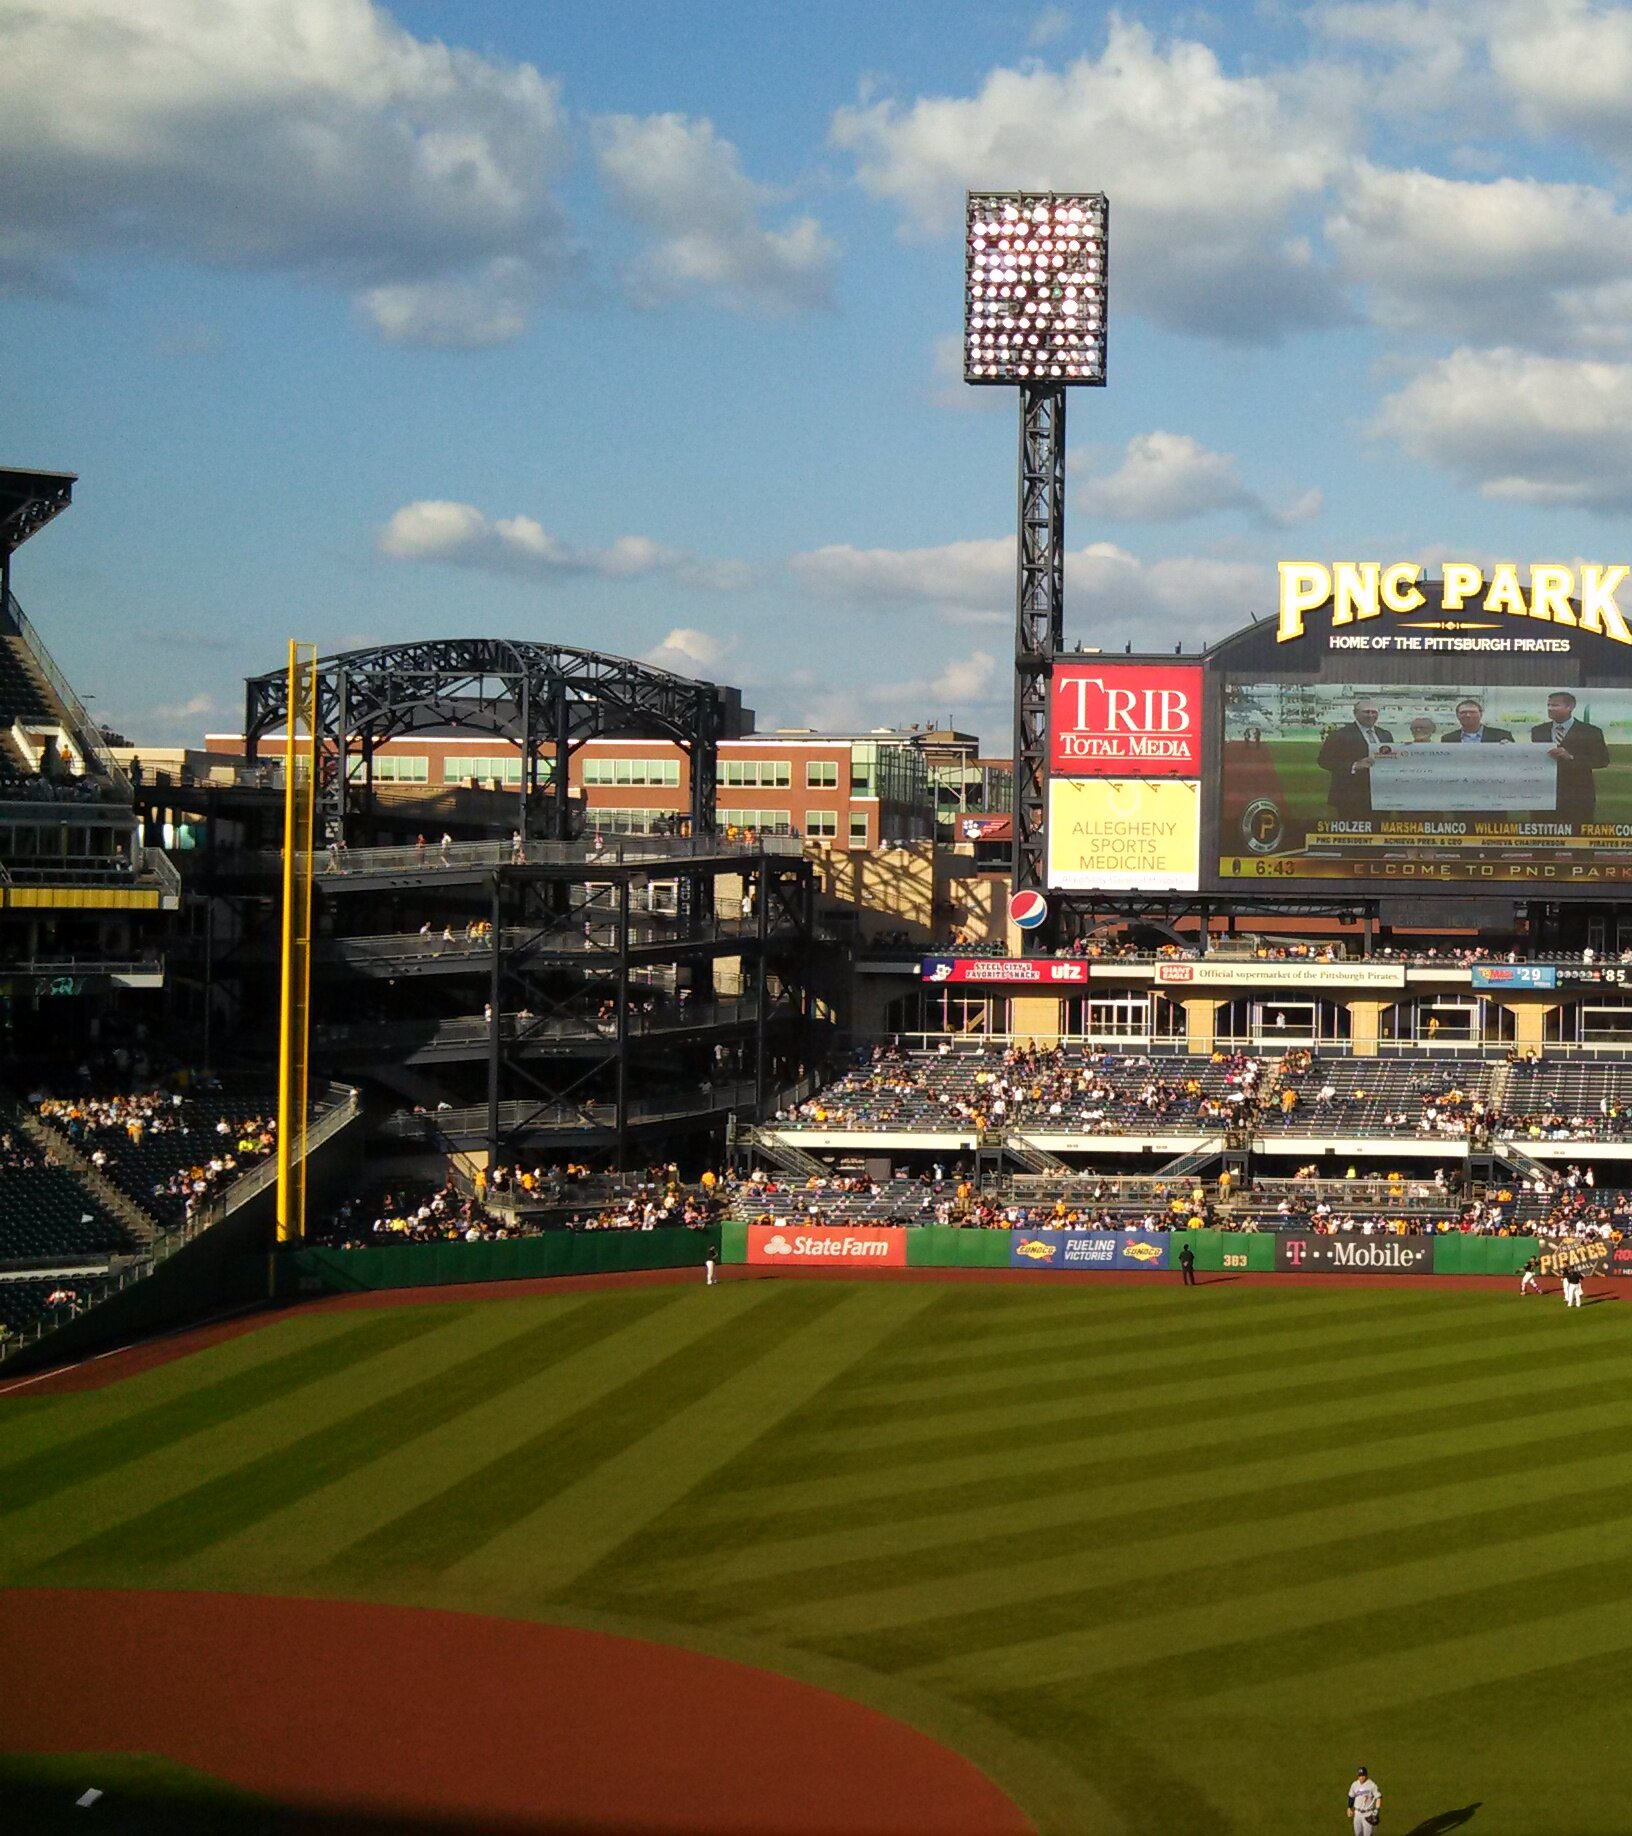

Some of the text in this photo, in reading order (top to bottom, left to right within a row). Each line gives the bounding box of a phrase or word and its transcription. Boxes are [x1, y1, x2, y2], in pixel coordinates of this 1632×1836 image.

[1276, 561, 1632, 646] PNC PARK
[1329, 636, 1570, 652] HOME OF THE PITTSBURGH PIRATES
[1059, 678, 1190, 732] TRIB
[1060, 735, 1192, 757] TOTAL MEDIA
[1072, 821, 1177, 836] ALLEGHENY
[1091, 838, 1157, 853] SPORTS
[1080, 855, 1167, 870] MEDICINE
[1256, 860, 1296, 875] 6:43
[1353, 864, 1451, 876] ELCOME
[1465, 865, 1494, 876] TO
[1510, 866, 1556, 877] PNC
[975, 963, 1001, 971] STEEL
[1051, 963, 1081, 979] utz
[1162, 966, 1190, 974] GIANT
[1199, 969, 1234, 979] Official
[1236, 970, 1291, 981] supermarket
[1292, 969, 1303, 979] of
[1304, 970, 1317, 980] the
[1320, 970, 1365, 982] Pittsburgh
[1018, 1246, 1057, 1255] SUNOCO
[1066, 1239, 1116, 1251] FUELING
[1124, 1247, 1162, 1256] SUNOCO
[1064, 1250, 1113, 1261] VICTORIES
[1223, 1254, 1248, 1267] 383
[1540, 1242, 1608, 1275] PIRATES
